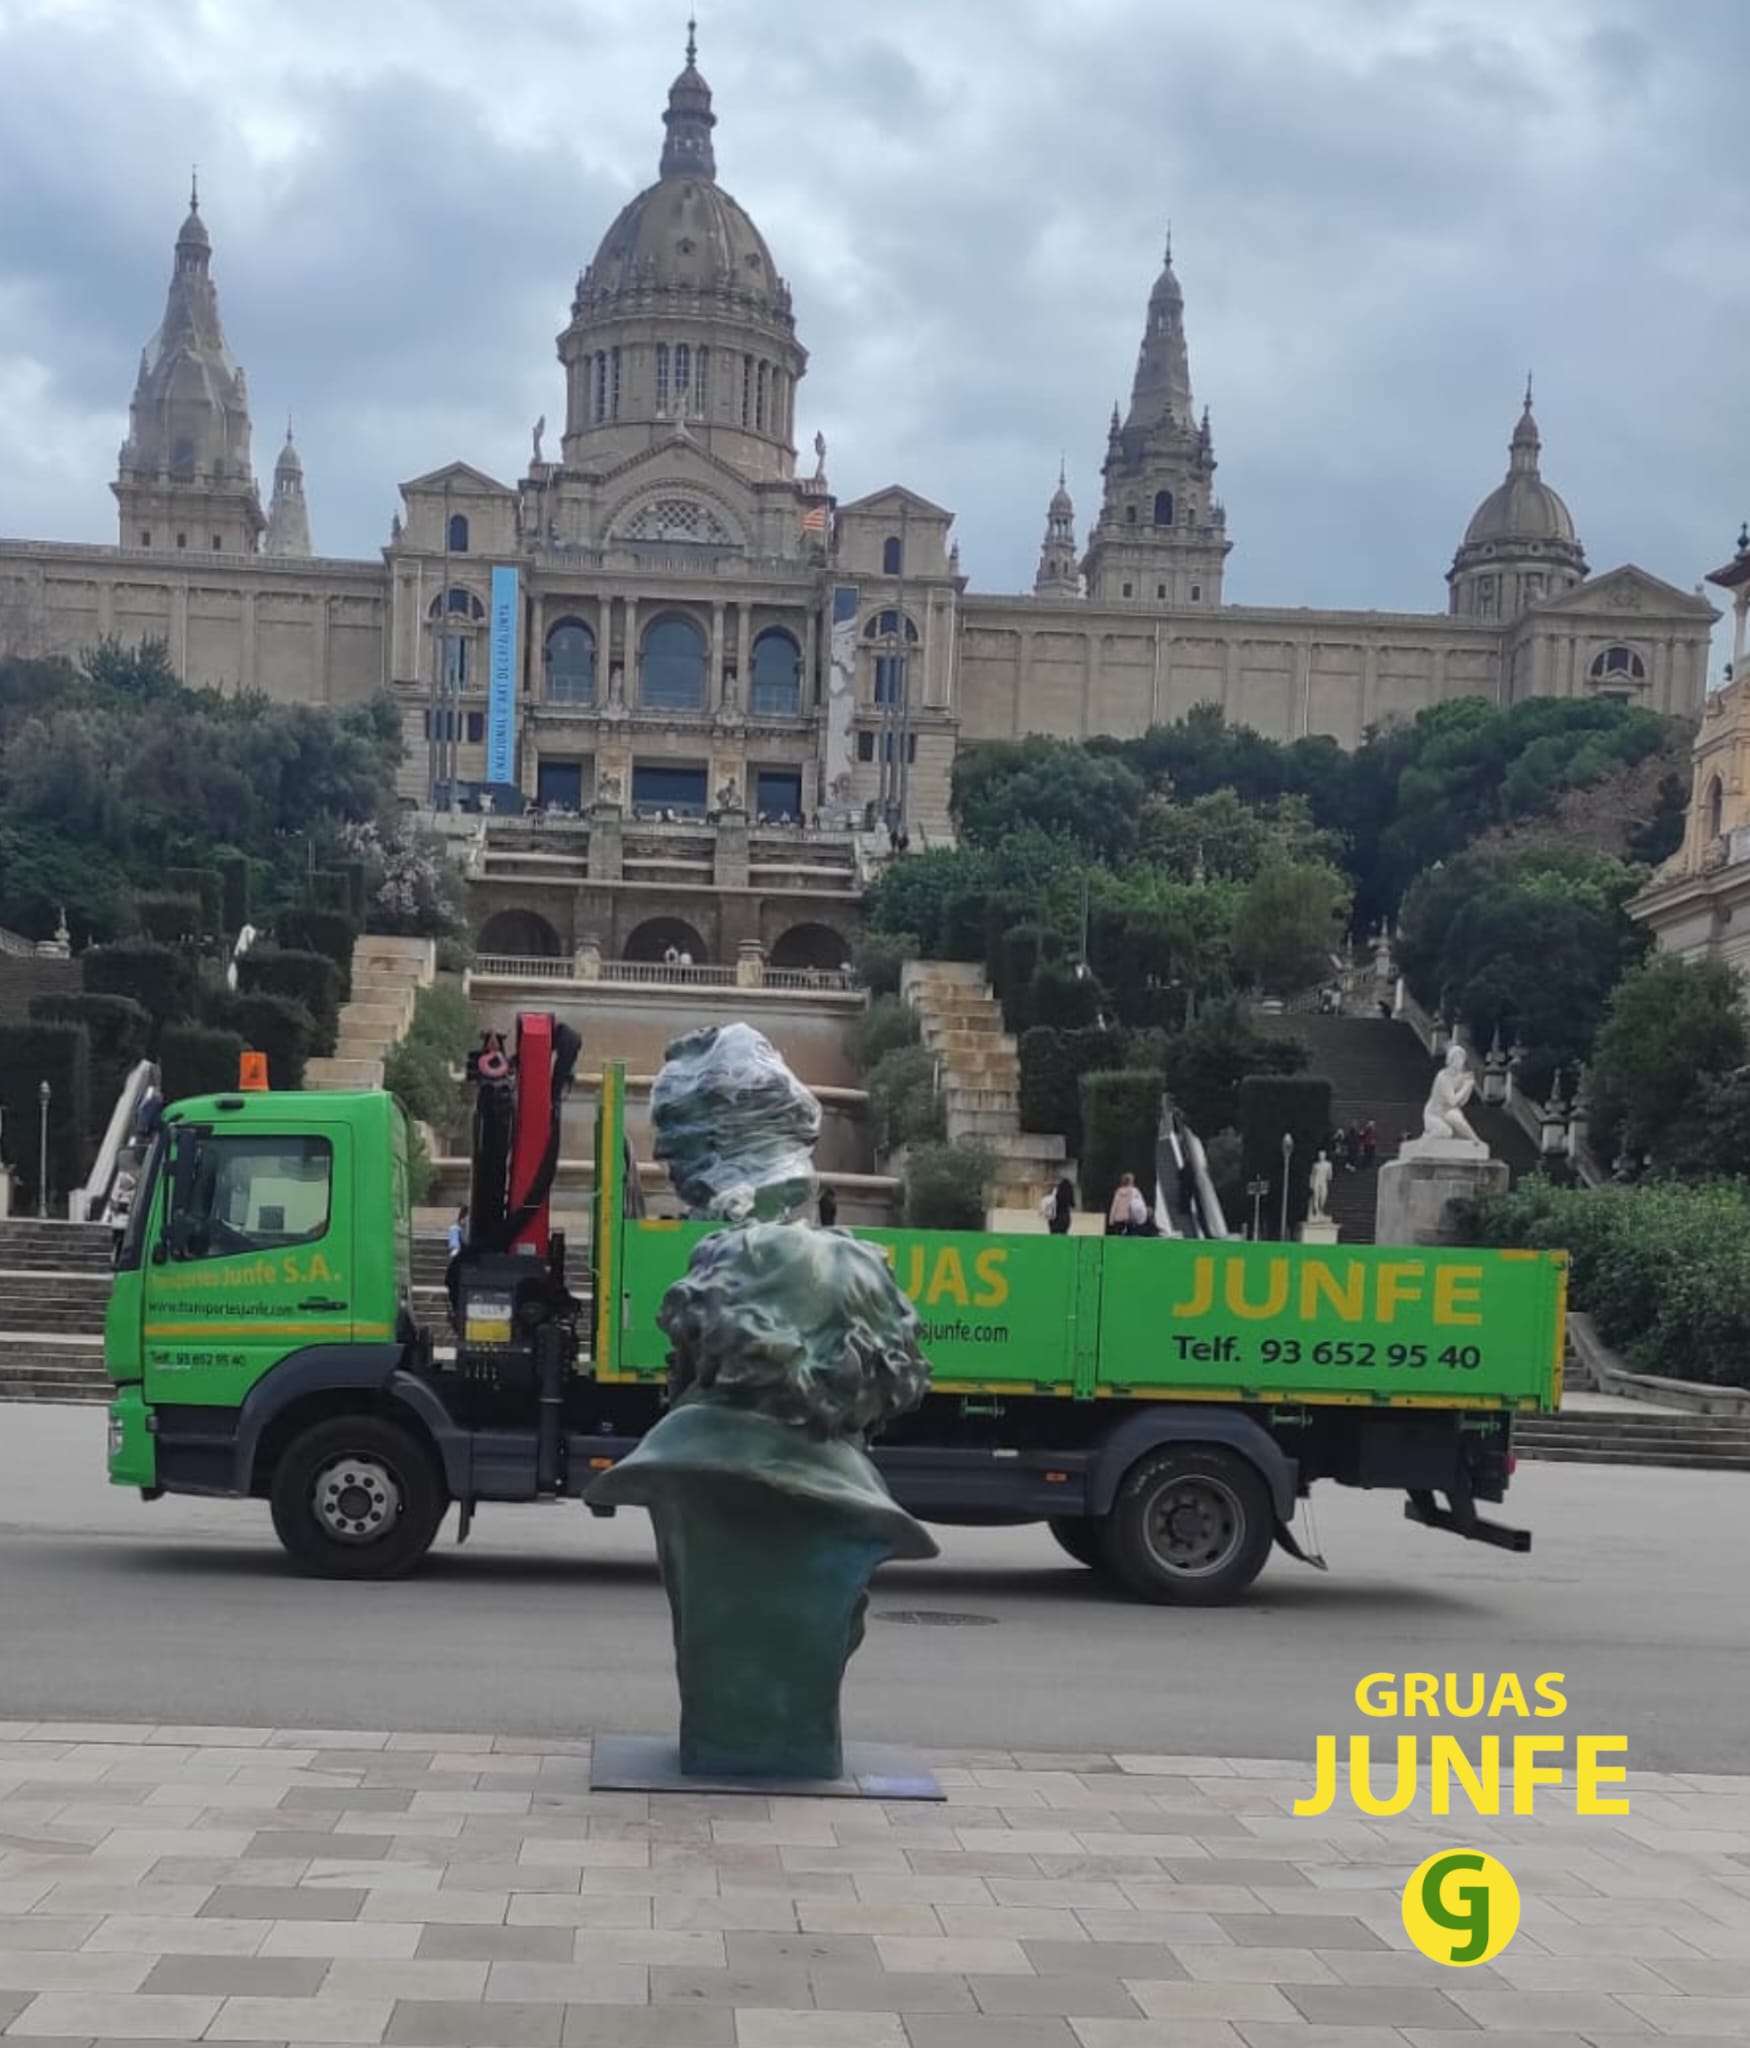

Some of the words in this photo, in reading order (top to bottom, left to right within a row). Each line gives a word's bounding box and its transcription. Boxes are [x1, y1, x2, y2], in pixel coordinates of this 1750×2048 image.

[283, 1252, 341, 1284] S.A.
[886, 1242, 1009, 1307] UAS
[1172, 1256, 1483, 1325] JUNFE
[1172, 1335, 1241, 1362] Telf.
[1260, 1339, 1301, 1364] 93
[1312, 1341, 1376, 1367] 652
[1386, 1344, 1427, 1369] 95
[1437, 1346, 1481, 1370] 40
